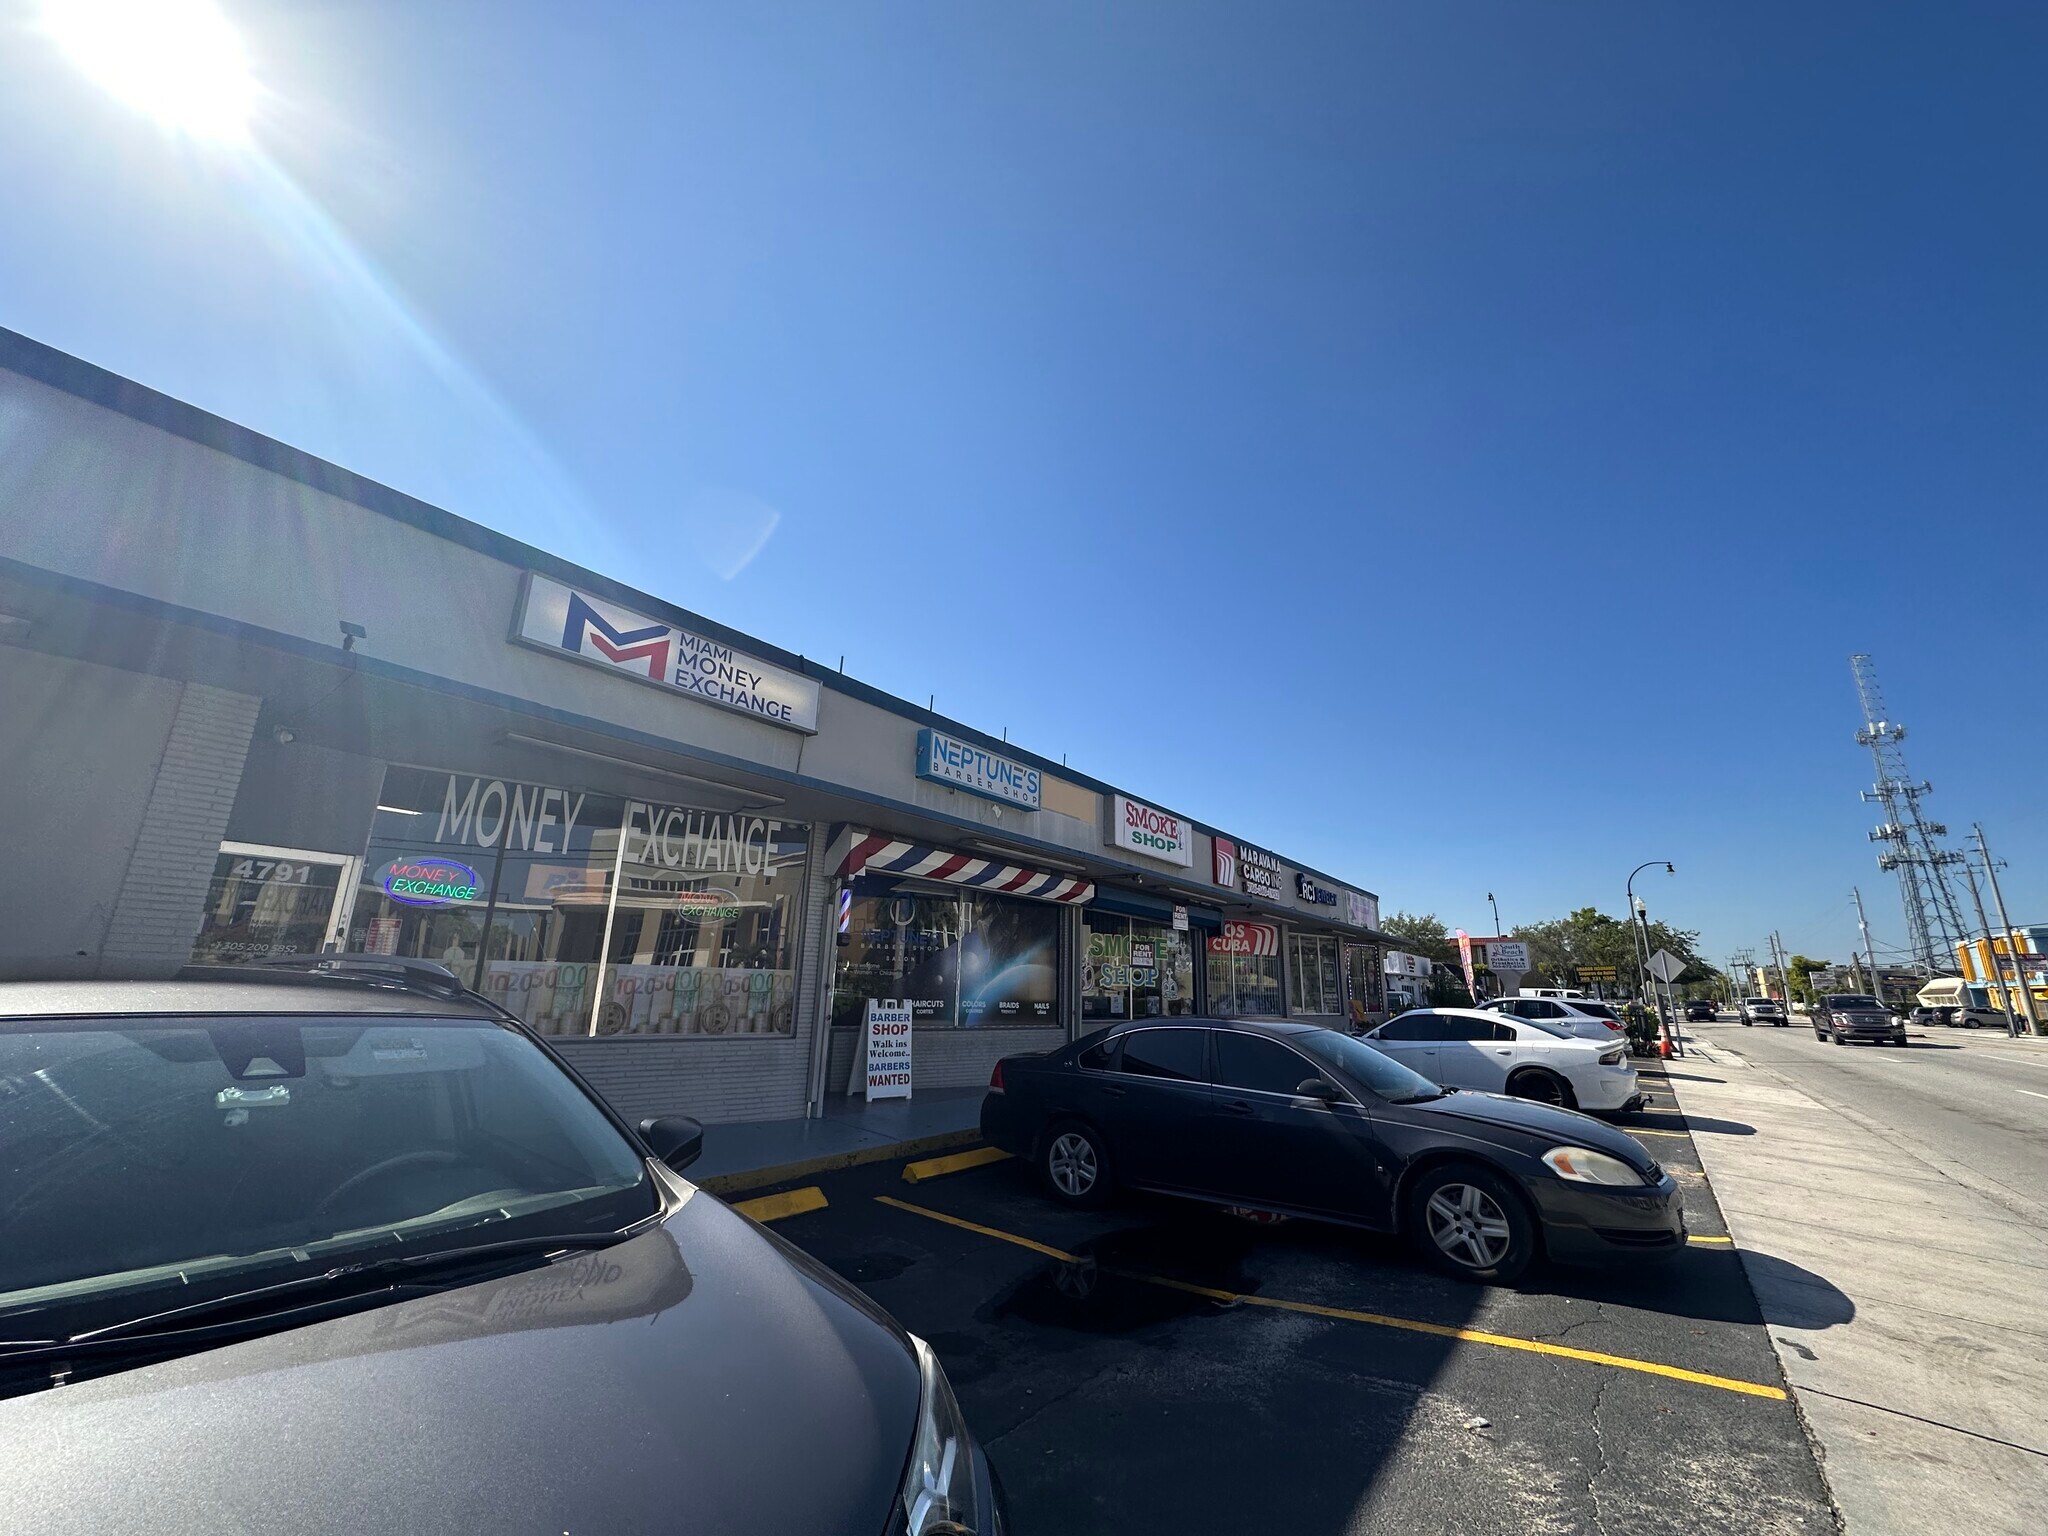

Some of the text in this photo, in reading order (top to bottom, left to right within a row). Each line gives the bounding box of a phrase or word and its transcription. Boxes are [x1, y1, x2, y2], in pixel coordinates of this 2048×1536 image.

[680, 632, 732, 664] MIAMI
[677, 648, 762, 690] MONEY
[674, 670, 792, 722] EXCHANGE
[933, 735, 1038, 794] NEPTUNE'S
[933, 762, 1038, 805] BARBER SHOP
[435, 775, 782, 877] MONEY EXCHANGE
[1125, 801, 1179, 840] SMOKE
[1131, 830, 1177, 852] SHOP
[232, 860, 310, 883] 4791
[389, 863, 461, 882] MONEY
[1243, 864, 1271, 886] CARGO
[391, 878, 477, 900] EXCHANGE
[682, 904, 739, 918] EXCHANGE
[1212, 938, 1251, 952] CUBA
[1100, 963, 1160, 988] SHOP
[911, 1000, 944, 1008] HAIRCUTS
[962, 1000, 986, 1008] COLORS
[870, 1012, 910, 1022] BARBER
[872, 1024, 909, 1036] SHOP
[872, 1040, 908, 1048] Walk ins
[868, 1062, 910, 1072] BARBERS
[868, 1073, 910, 1087] WANTED
